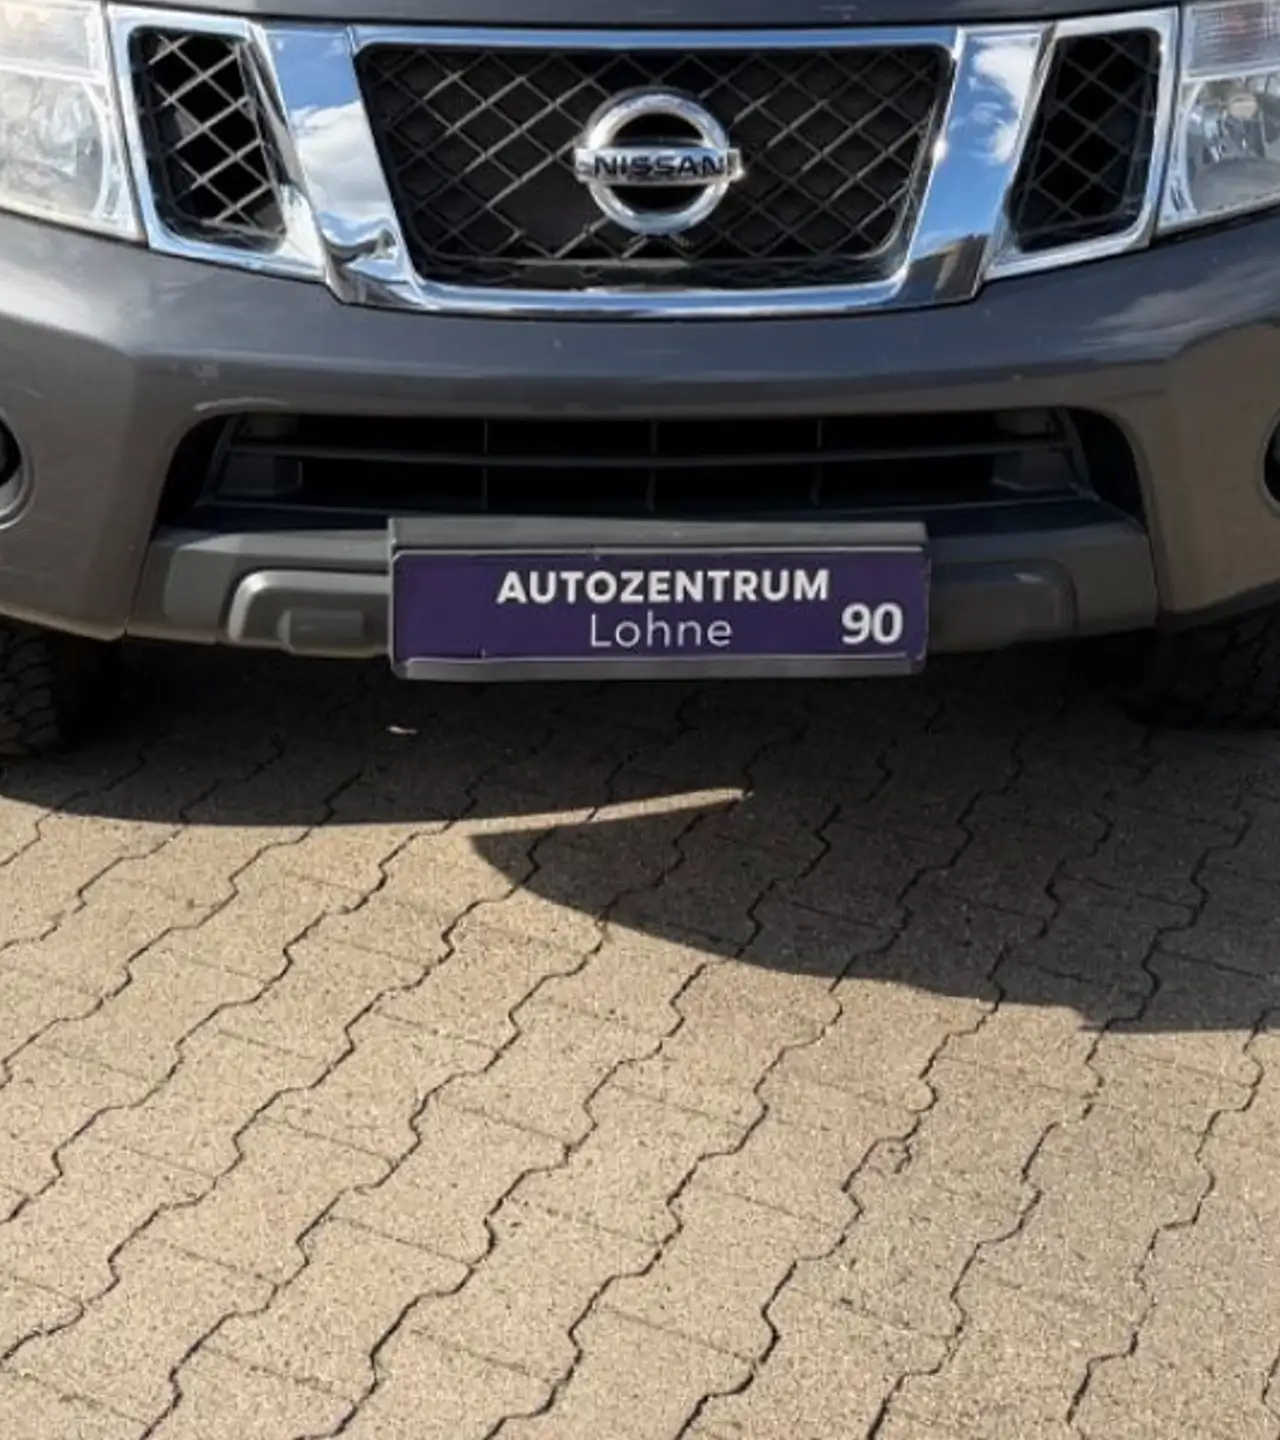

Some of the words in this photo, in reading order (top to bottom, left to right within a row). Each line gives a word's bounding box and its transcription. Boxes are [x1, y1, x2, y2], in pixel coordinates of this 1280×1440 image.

[593, 154, 727, 177] NISSAN
[495, 568, 830, 605] AUTOZENTRUM
[590, 610, 734, 648] Lohne
[841, 602, 904, 646] 90
